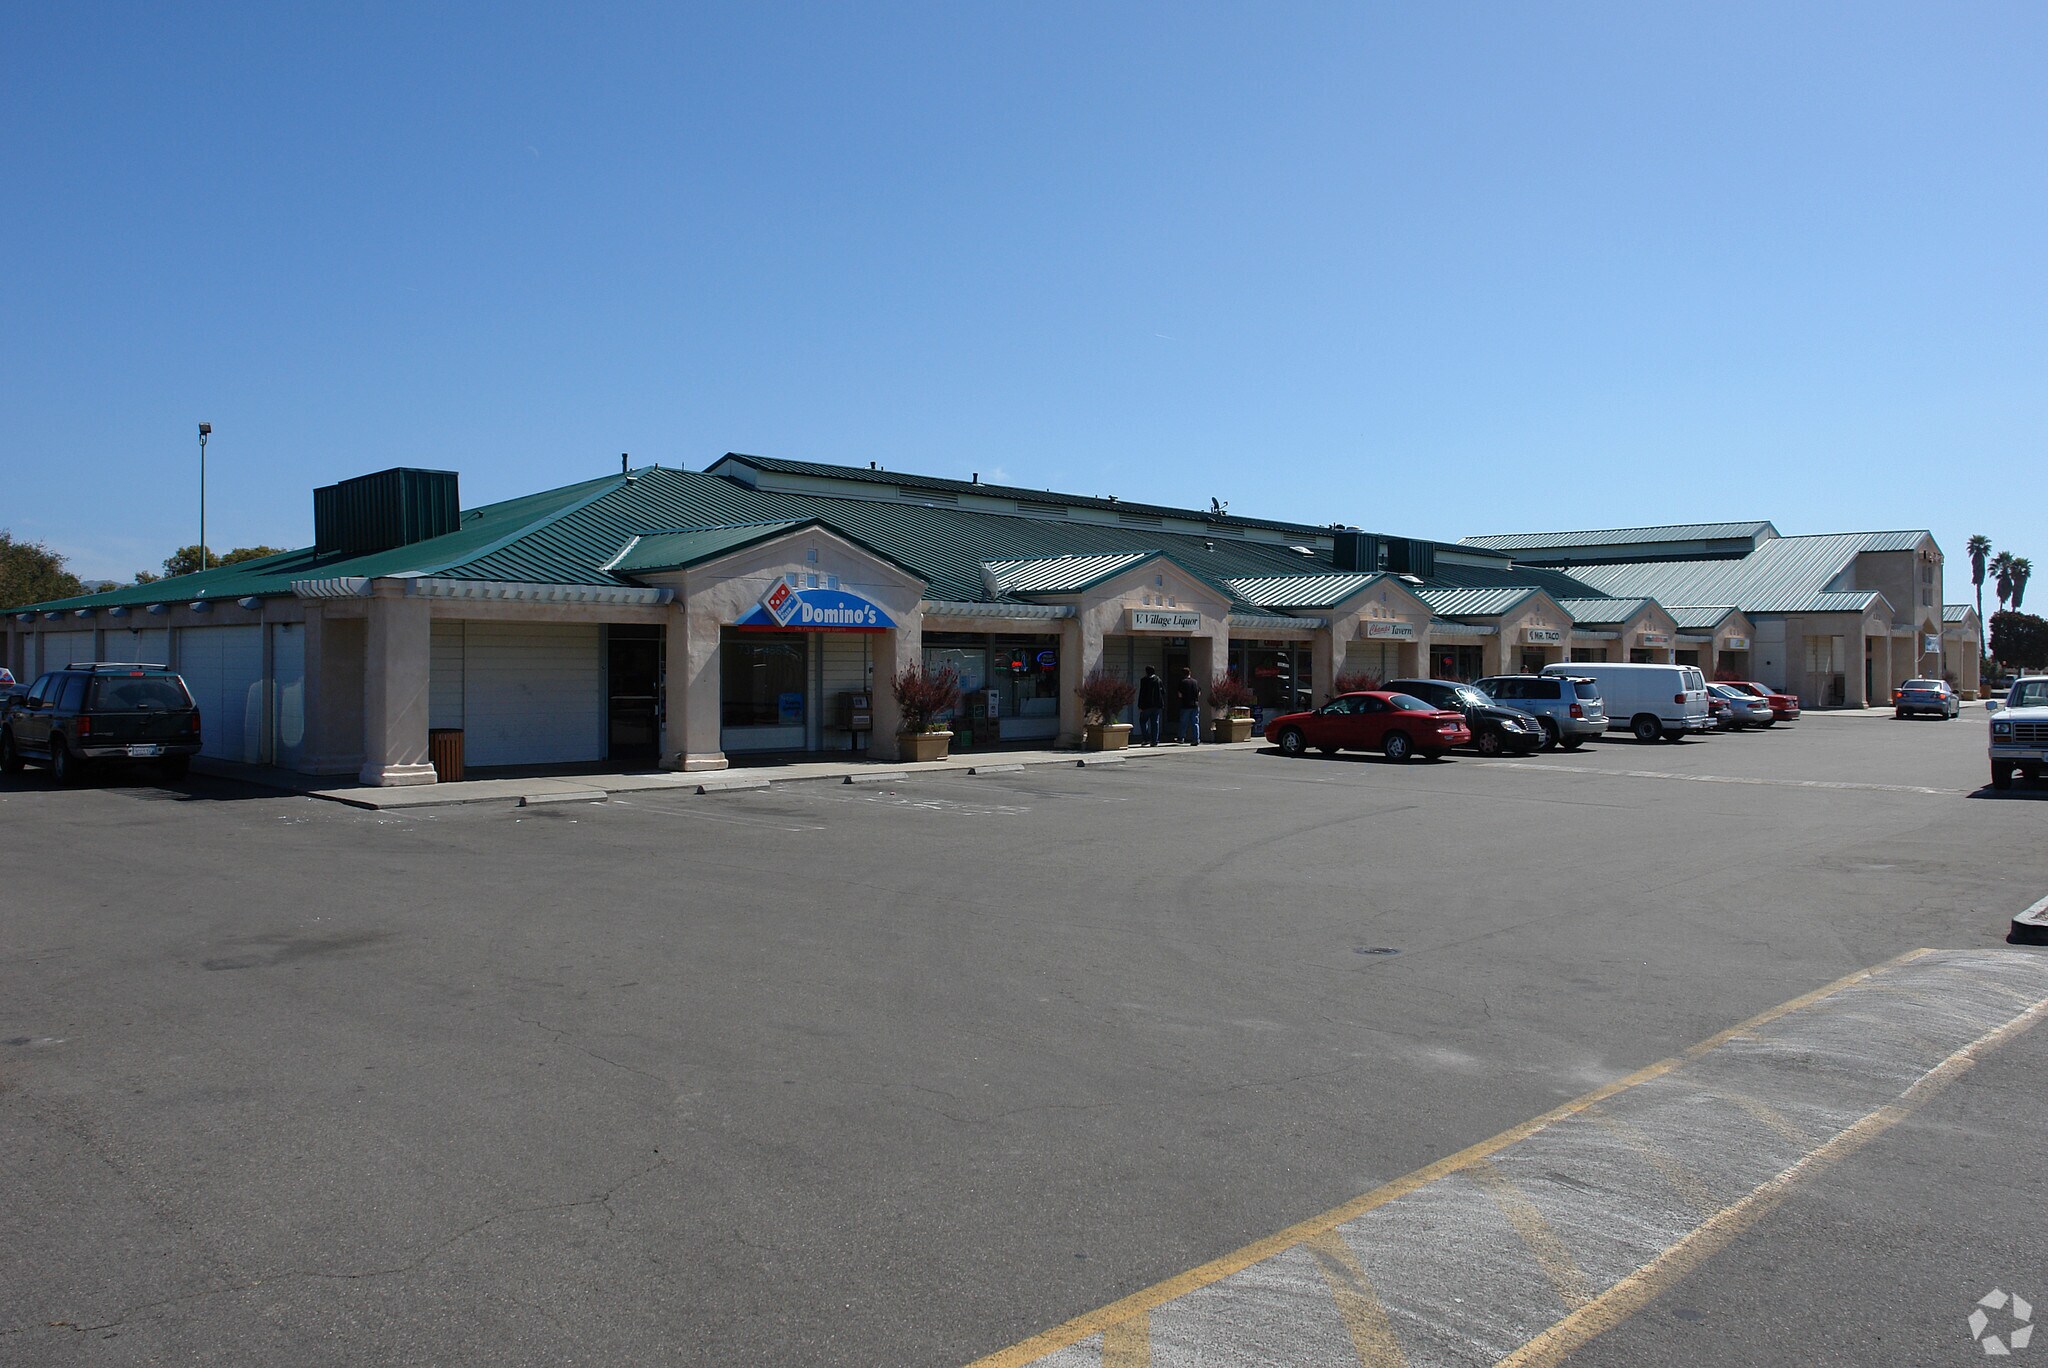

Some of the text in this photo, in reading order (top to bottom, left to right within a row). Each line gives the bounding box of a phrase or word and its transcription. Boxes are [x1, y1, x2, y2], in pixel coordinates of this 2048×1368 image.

[802, 602, 876, 624] Domino's
[1145, 614, 1171, 626] Village
[1173, 615, 1198, 627] Liquor
[1391, 624, 1412, 635] Tavern
[1535, 632, 1559, 640] MR. TACO
